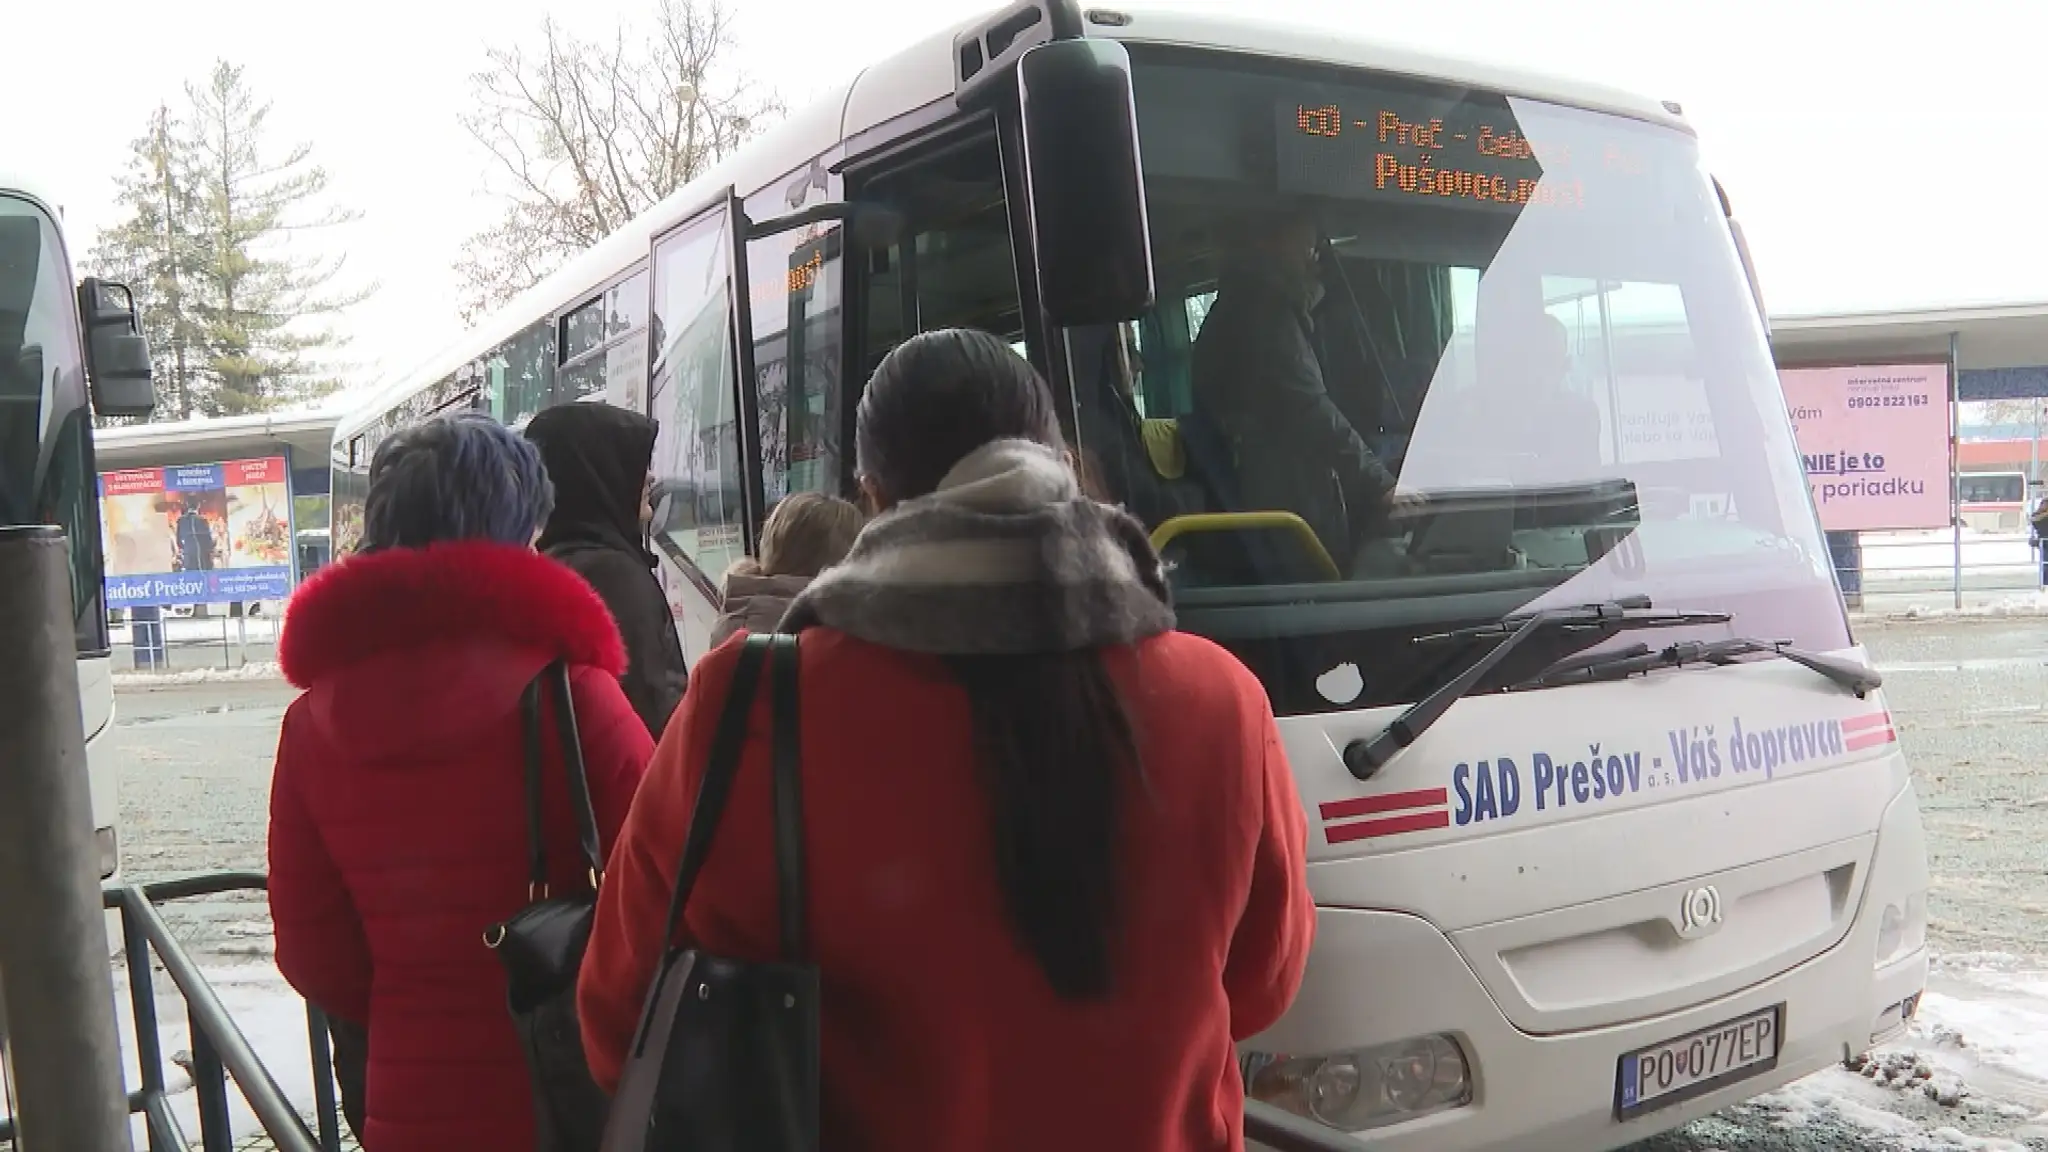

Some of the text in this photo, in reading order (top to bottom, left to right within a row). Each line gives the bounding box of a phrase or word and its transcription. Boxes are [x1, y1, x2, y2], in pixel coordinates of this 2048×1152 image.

[1788, 405, 1823, 420] Vám
[1802, 450, 1885, 475] NIE je to
[1822, 476, 1925, 504] poriadku
[107, 578, 204, 601] adosť Prešov
[1453, 757, 1521, 826] SAD
[1532, 742, 1643, 812] Prešov
[1668, 724, 1721, 784] Váš
[1730, 716, 1843, 780] dopravca
